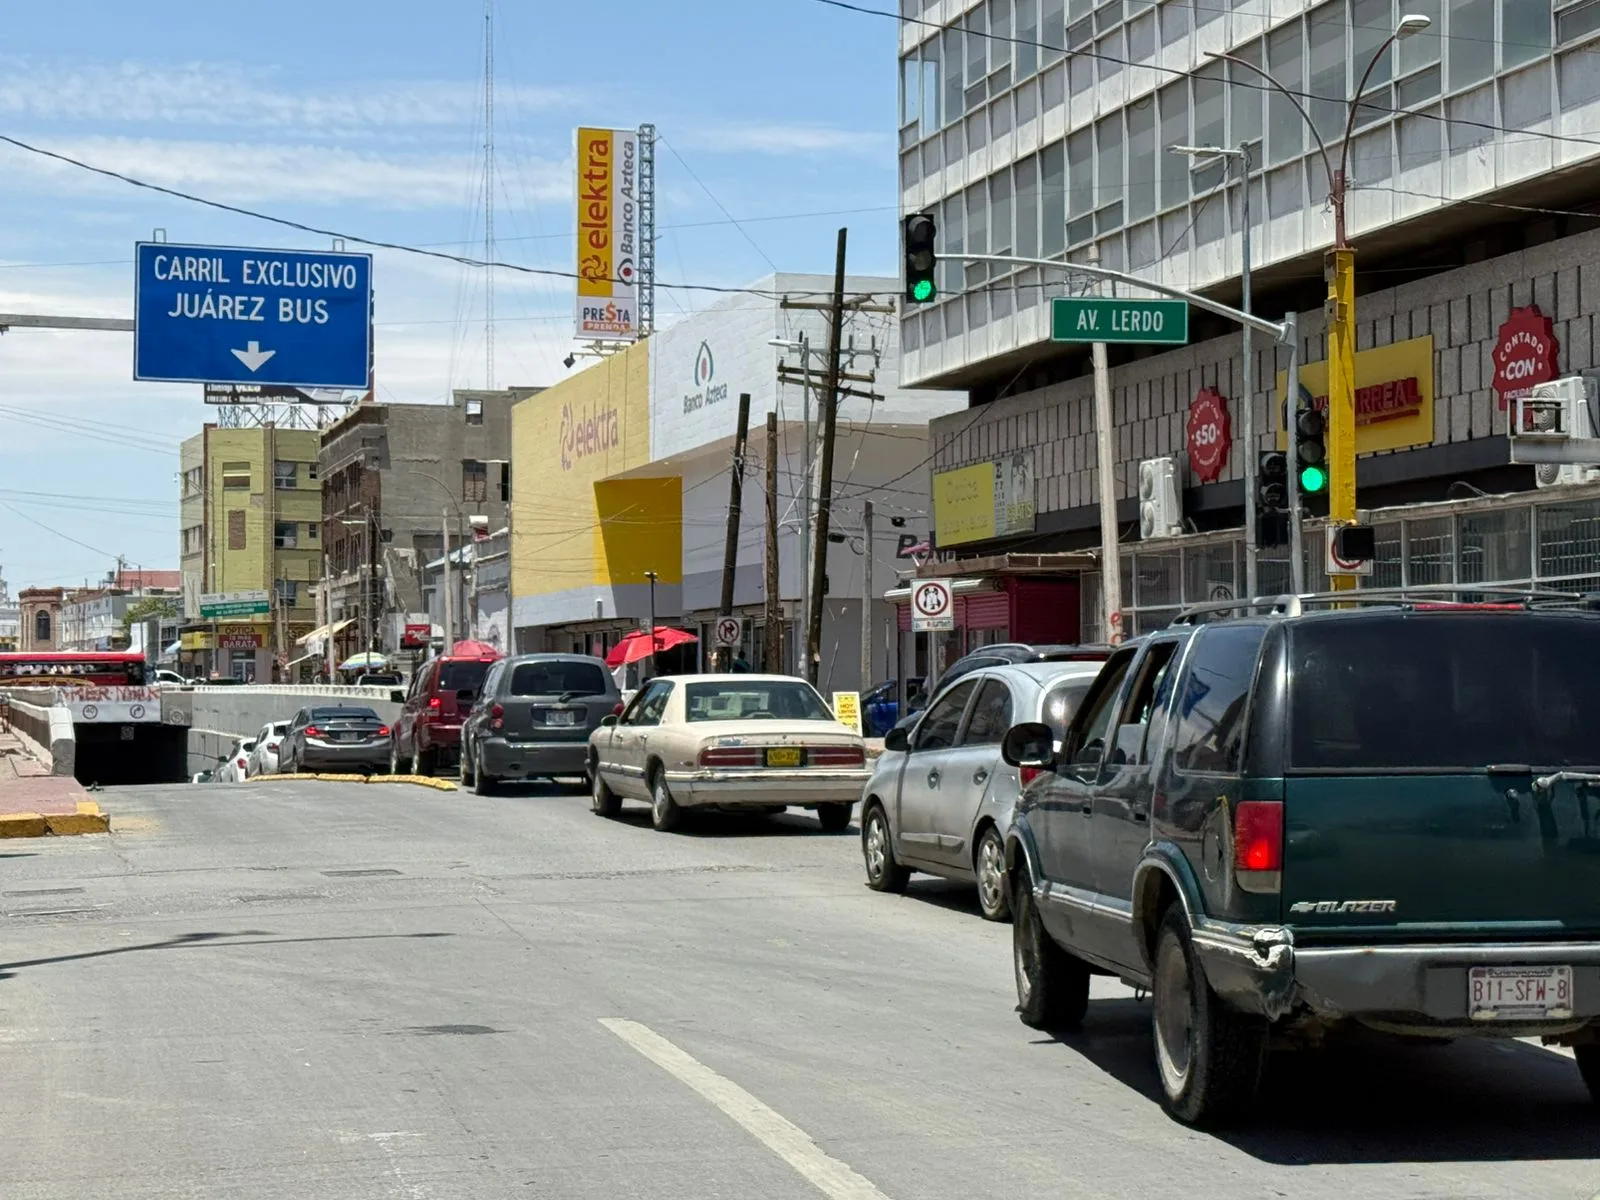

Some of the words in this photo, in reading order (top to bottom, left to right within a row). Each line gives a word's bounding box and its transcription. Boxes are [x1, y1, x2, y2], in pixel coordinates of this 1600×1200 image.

[621, 141, 634, 201] Azteca
[581, 139, 608, 250] elektra
[621, 202, 633, 255] Banco
[154, 255, 230, 283] CARRIL
[243, 260, 357, 290] EXCLUSIVO
[168, 288, 265, 322] JUÁREZ
[278, 298, 330, 324] BUS
[1077, 309, 1100, 331] AV.
[1112, 310, 1164, 332] LERDO
[1500, 331, 1544, 362] CONTADO
[1506, 357, 1536, 380] CON
[684, 393, 703, 414] Banco
[705, 383, 728, 406] Azteca
[575, 401, 619, 458] elektra
[1315, 900, 1397, 913] BLAZER
[1473, 978, 1568, 1002] B11-SFW-8
